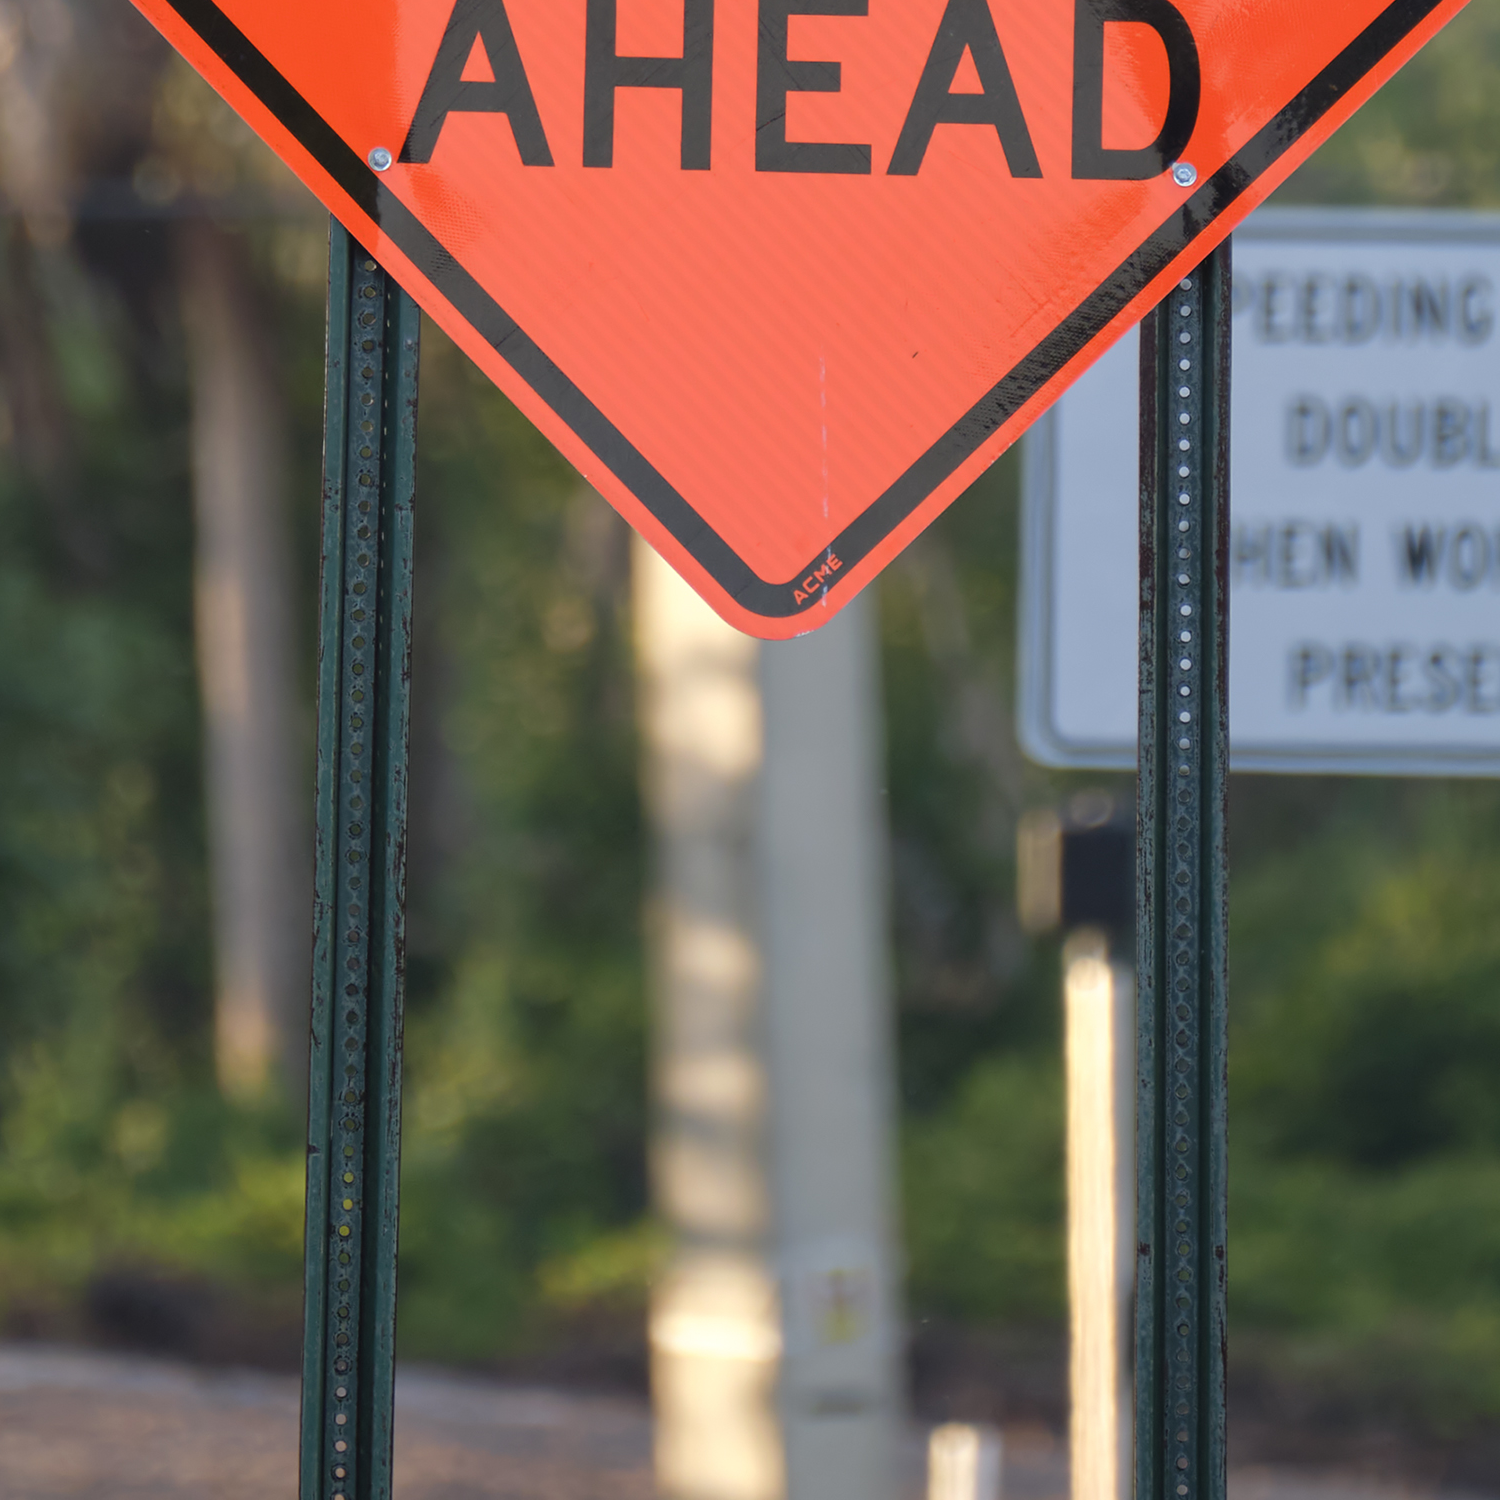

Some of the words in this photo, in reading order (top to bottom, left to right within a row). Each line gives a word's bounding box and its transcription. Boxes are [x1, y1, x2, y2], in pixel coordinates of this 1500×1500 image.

[1231, 271, 1496, 348] PEEDING
[793, 554, 843, 605] ACME
[1232, 516, 1360, 592] HEN
